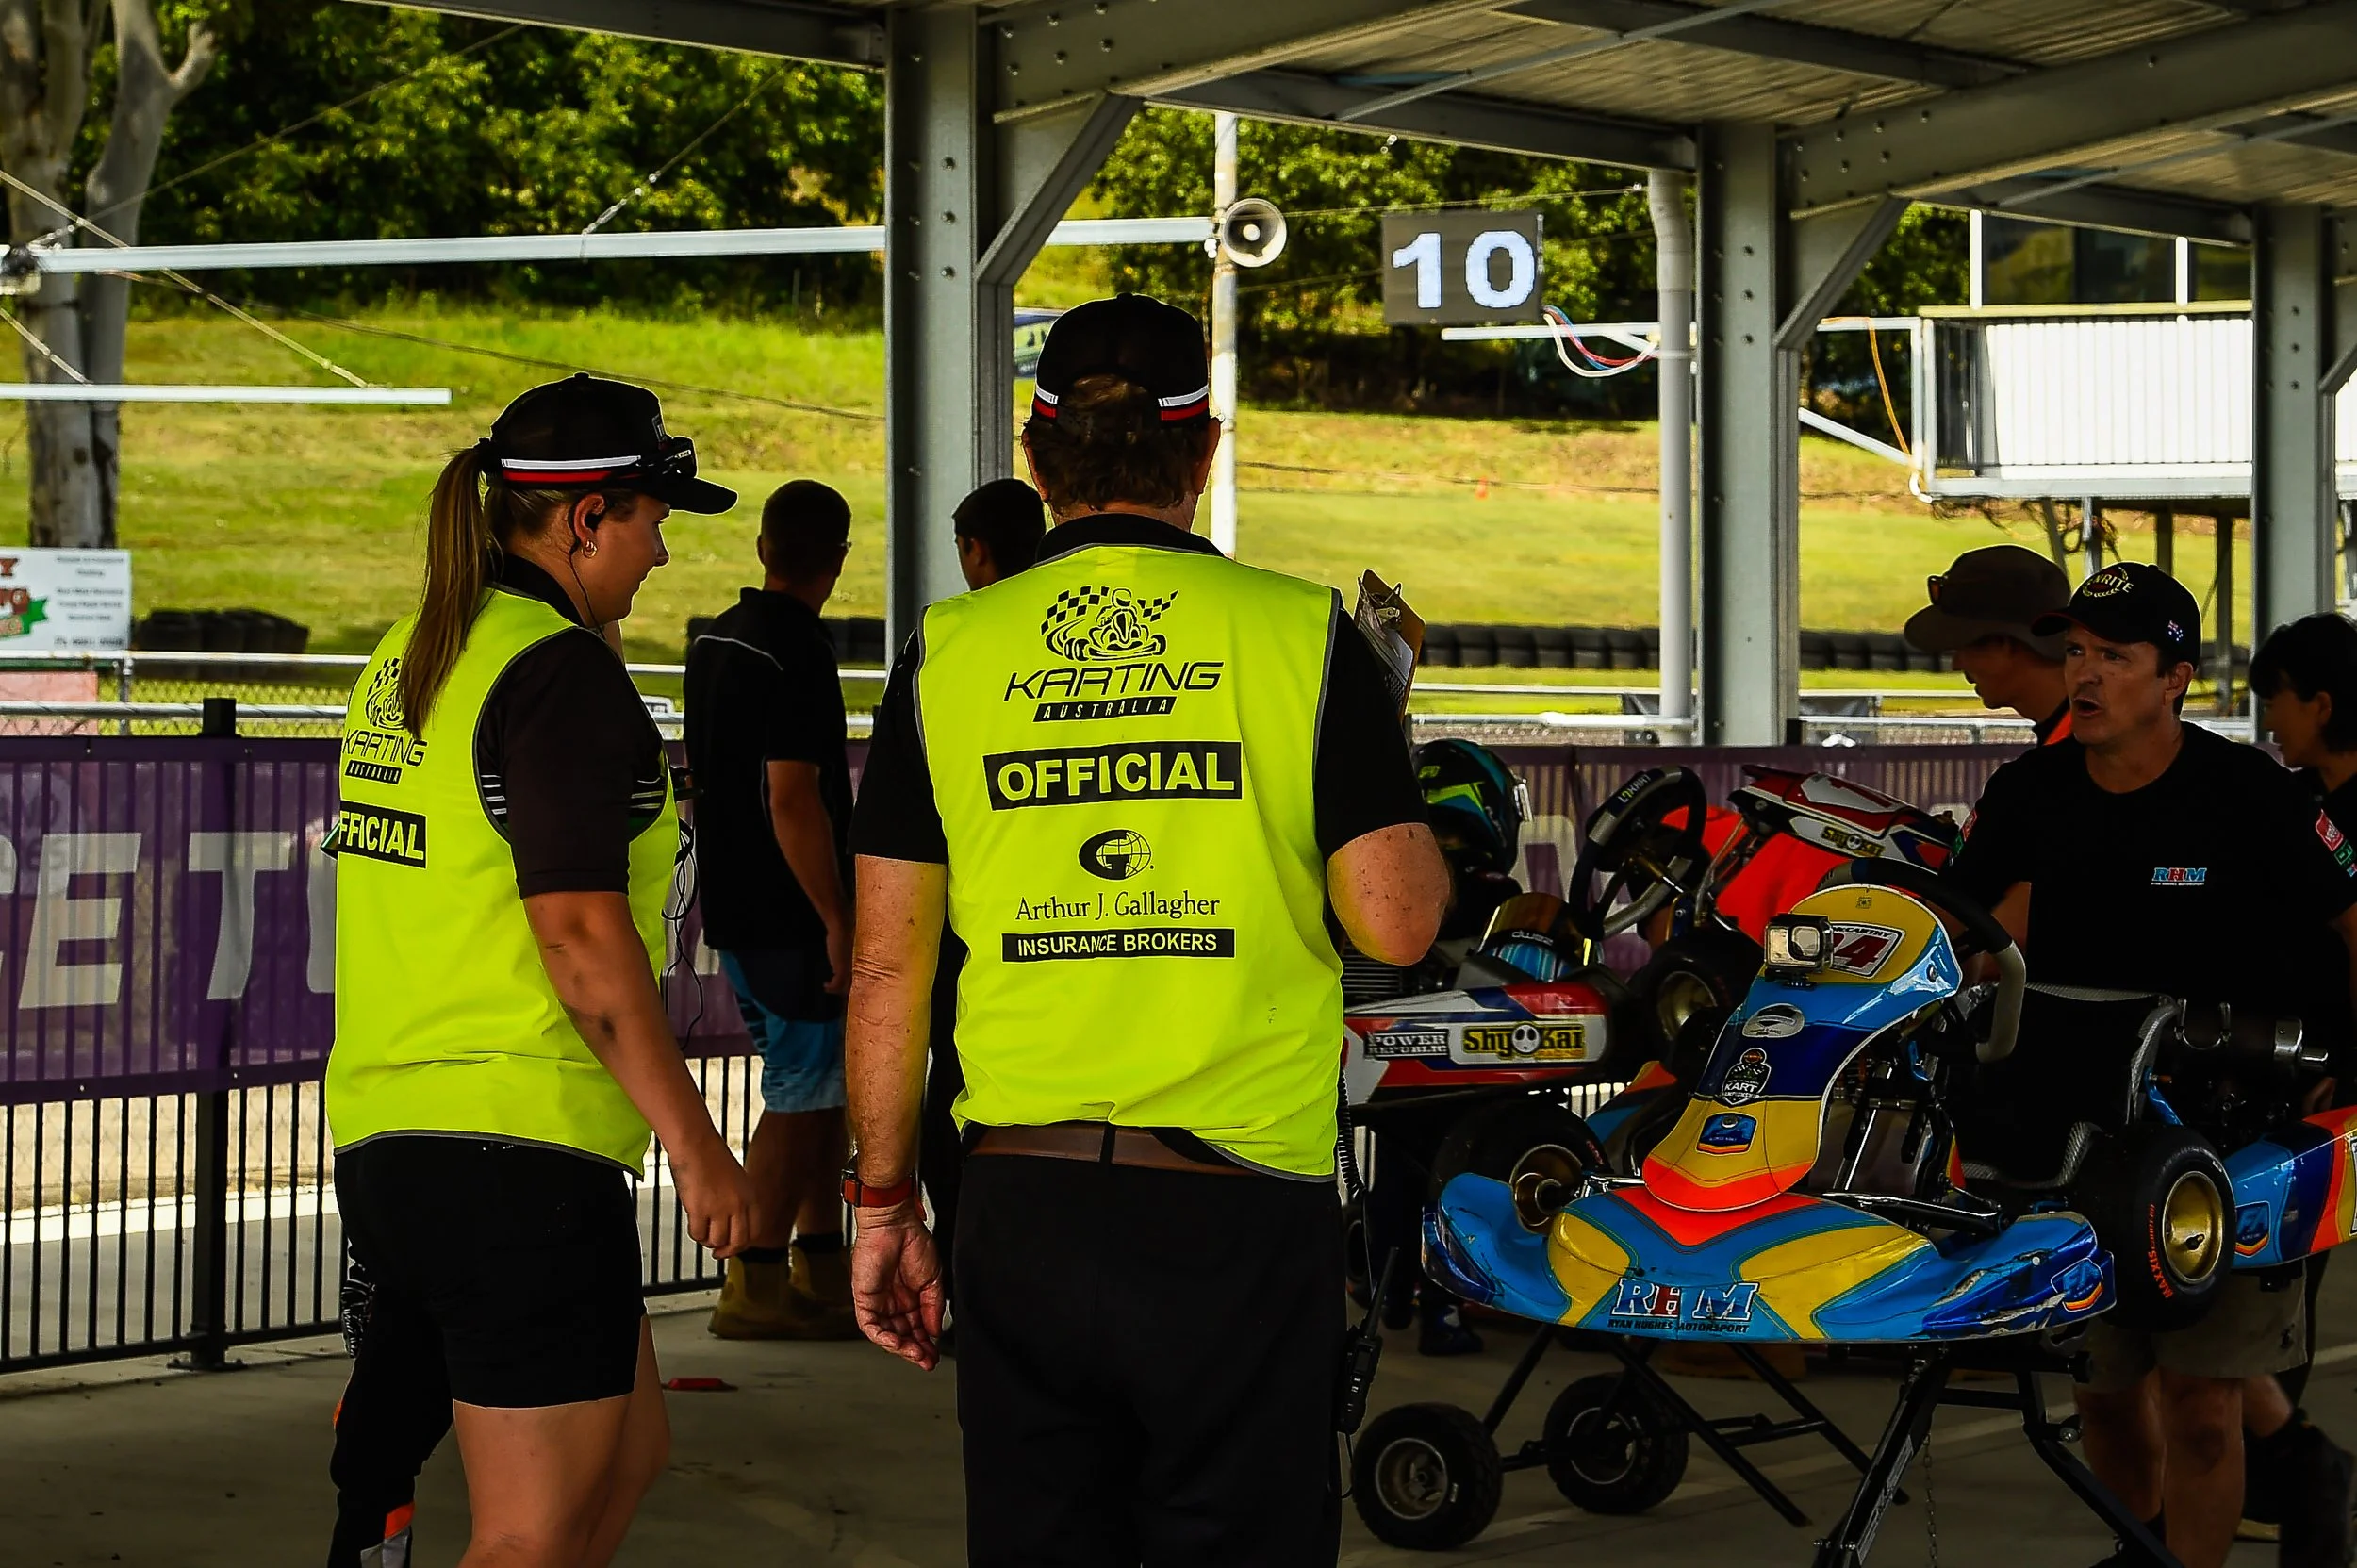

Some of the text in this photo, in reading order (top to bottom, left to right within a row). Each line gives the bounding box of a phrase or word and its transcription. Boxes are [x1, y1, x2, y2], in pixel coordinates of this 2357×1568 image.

[1393, 230, 1535, 308] 10
[1003, 661, 1224, 701] KARTING
[1043, 700, 1169, 719] AUSTRALIA
[342, 728, 427, 767] KARTING
[349, 761, 401, 783] AUSTRALIA
[997, 752, 1235, 801] OFFICIAL
[338, 810, 424, 860] FFICIAL
[2152, 867, 2207, 882] RHM
[1015, 890, 1220, 921] Arthur J. Gallagher
[1017, 932, 1217, 957] INSURANCE BROKERS
[1368, 1034, 1446, 1047] POWER
[1724, 1082, 1758, 1093] KART
[2149, 1250, 2173, 1298] MAXXIS
[1611, 1278, 1759, 1321] RHM
[1607, 1318, 1750, 1333] RYAN HUGHES MOTORSPORT
